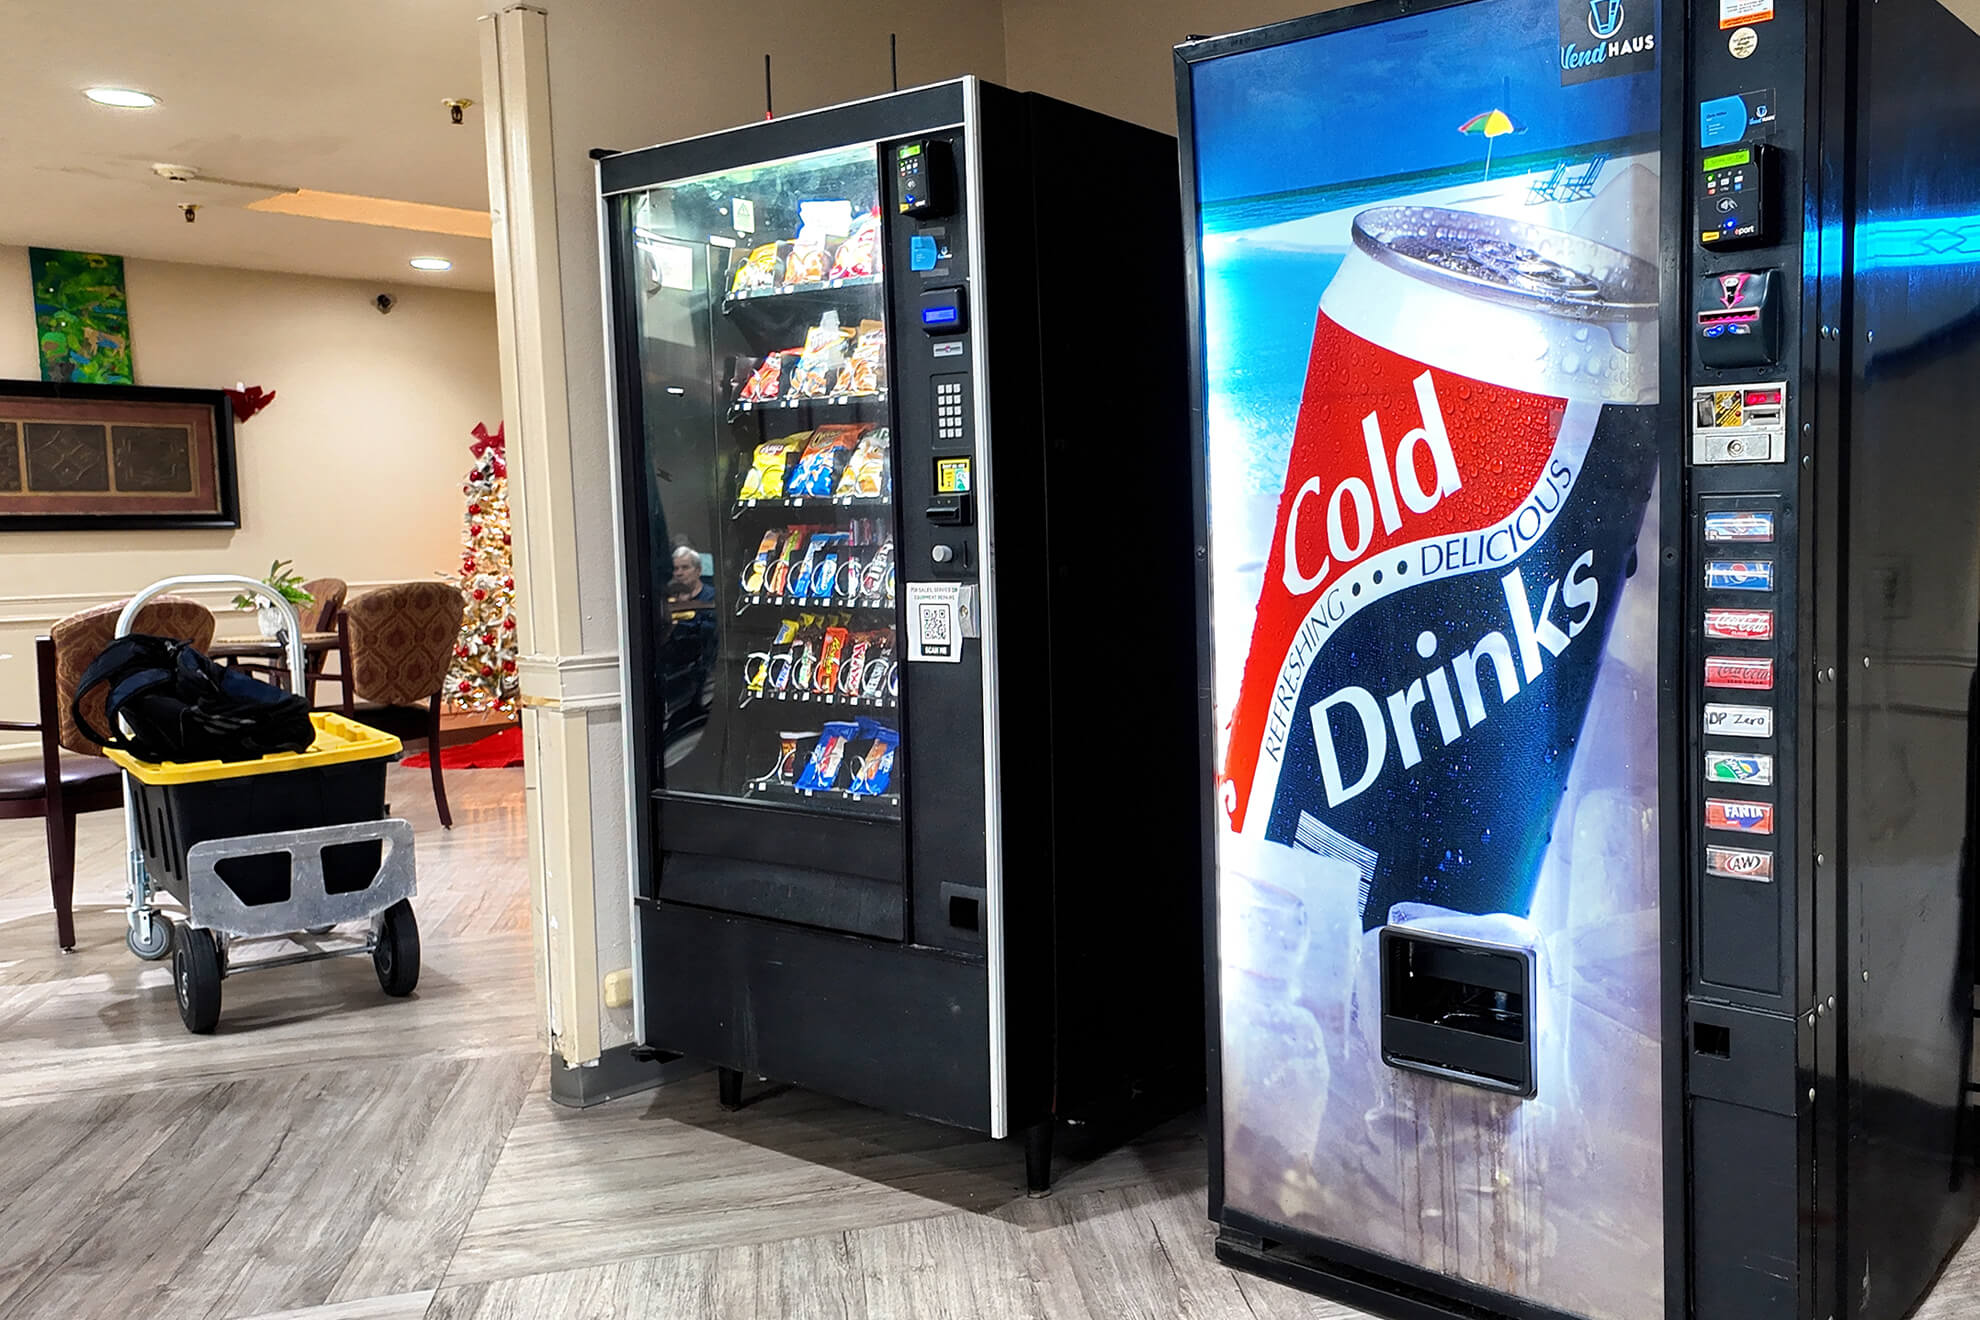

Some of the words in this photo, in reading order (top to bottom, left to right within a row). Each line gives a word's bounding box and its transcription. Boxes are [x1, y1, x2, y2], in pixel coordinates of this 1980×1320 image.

[1608, 34, 1655, 57] HAUS
[1282, 369, 1463, 596] Cold
[1265, 588, 1345, 762] REFRESHING
[1421, 459, 1572, 577] DELICIOUS
[1309, 549, 1599, 809] Drinks
[1709, 711, 1728, 726] DP
[1733, 713, 1765, 726] Zero
[1725, 805, 1765, 819] FANTA
[1732, 855, 1756, 870] AW
